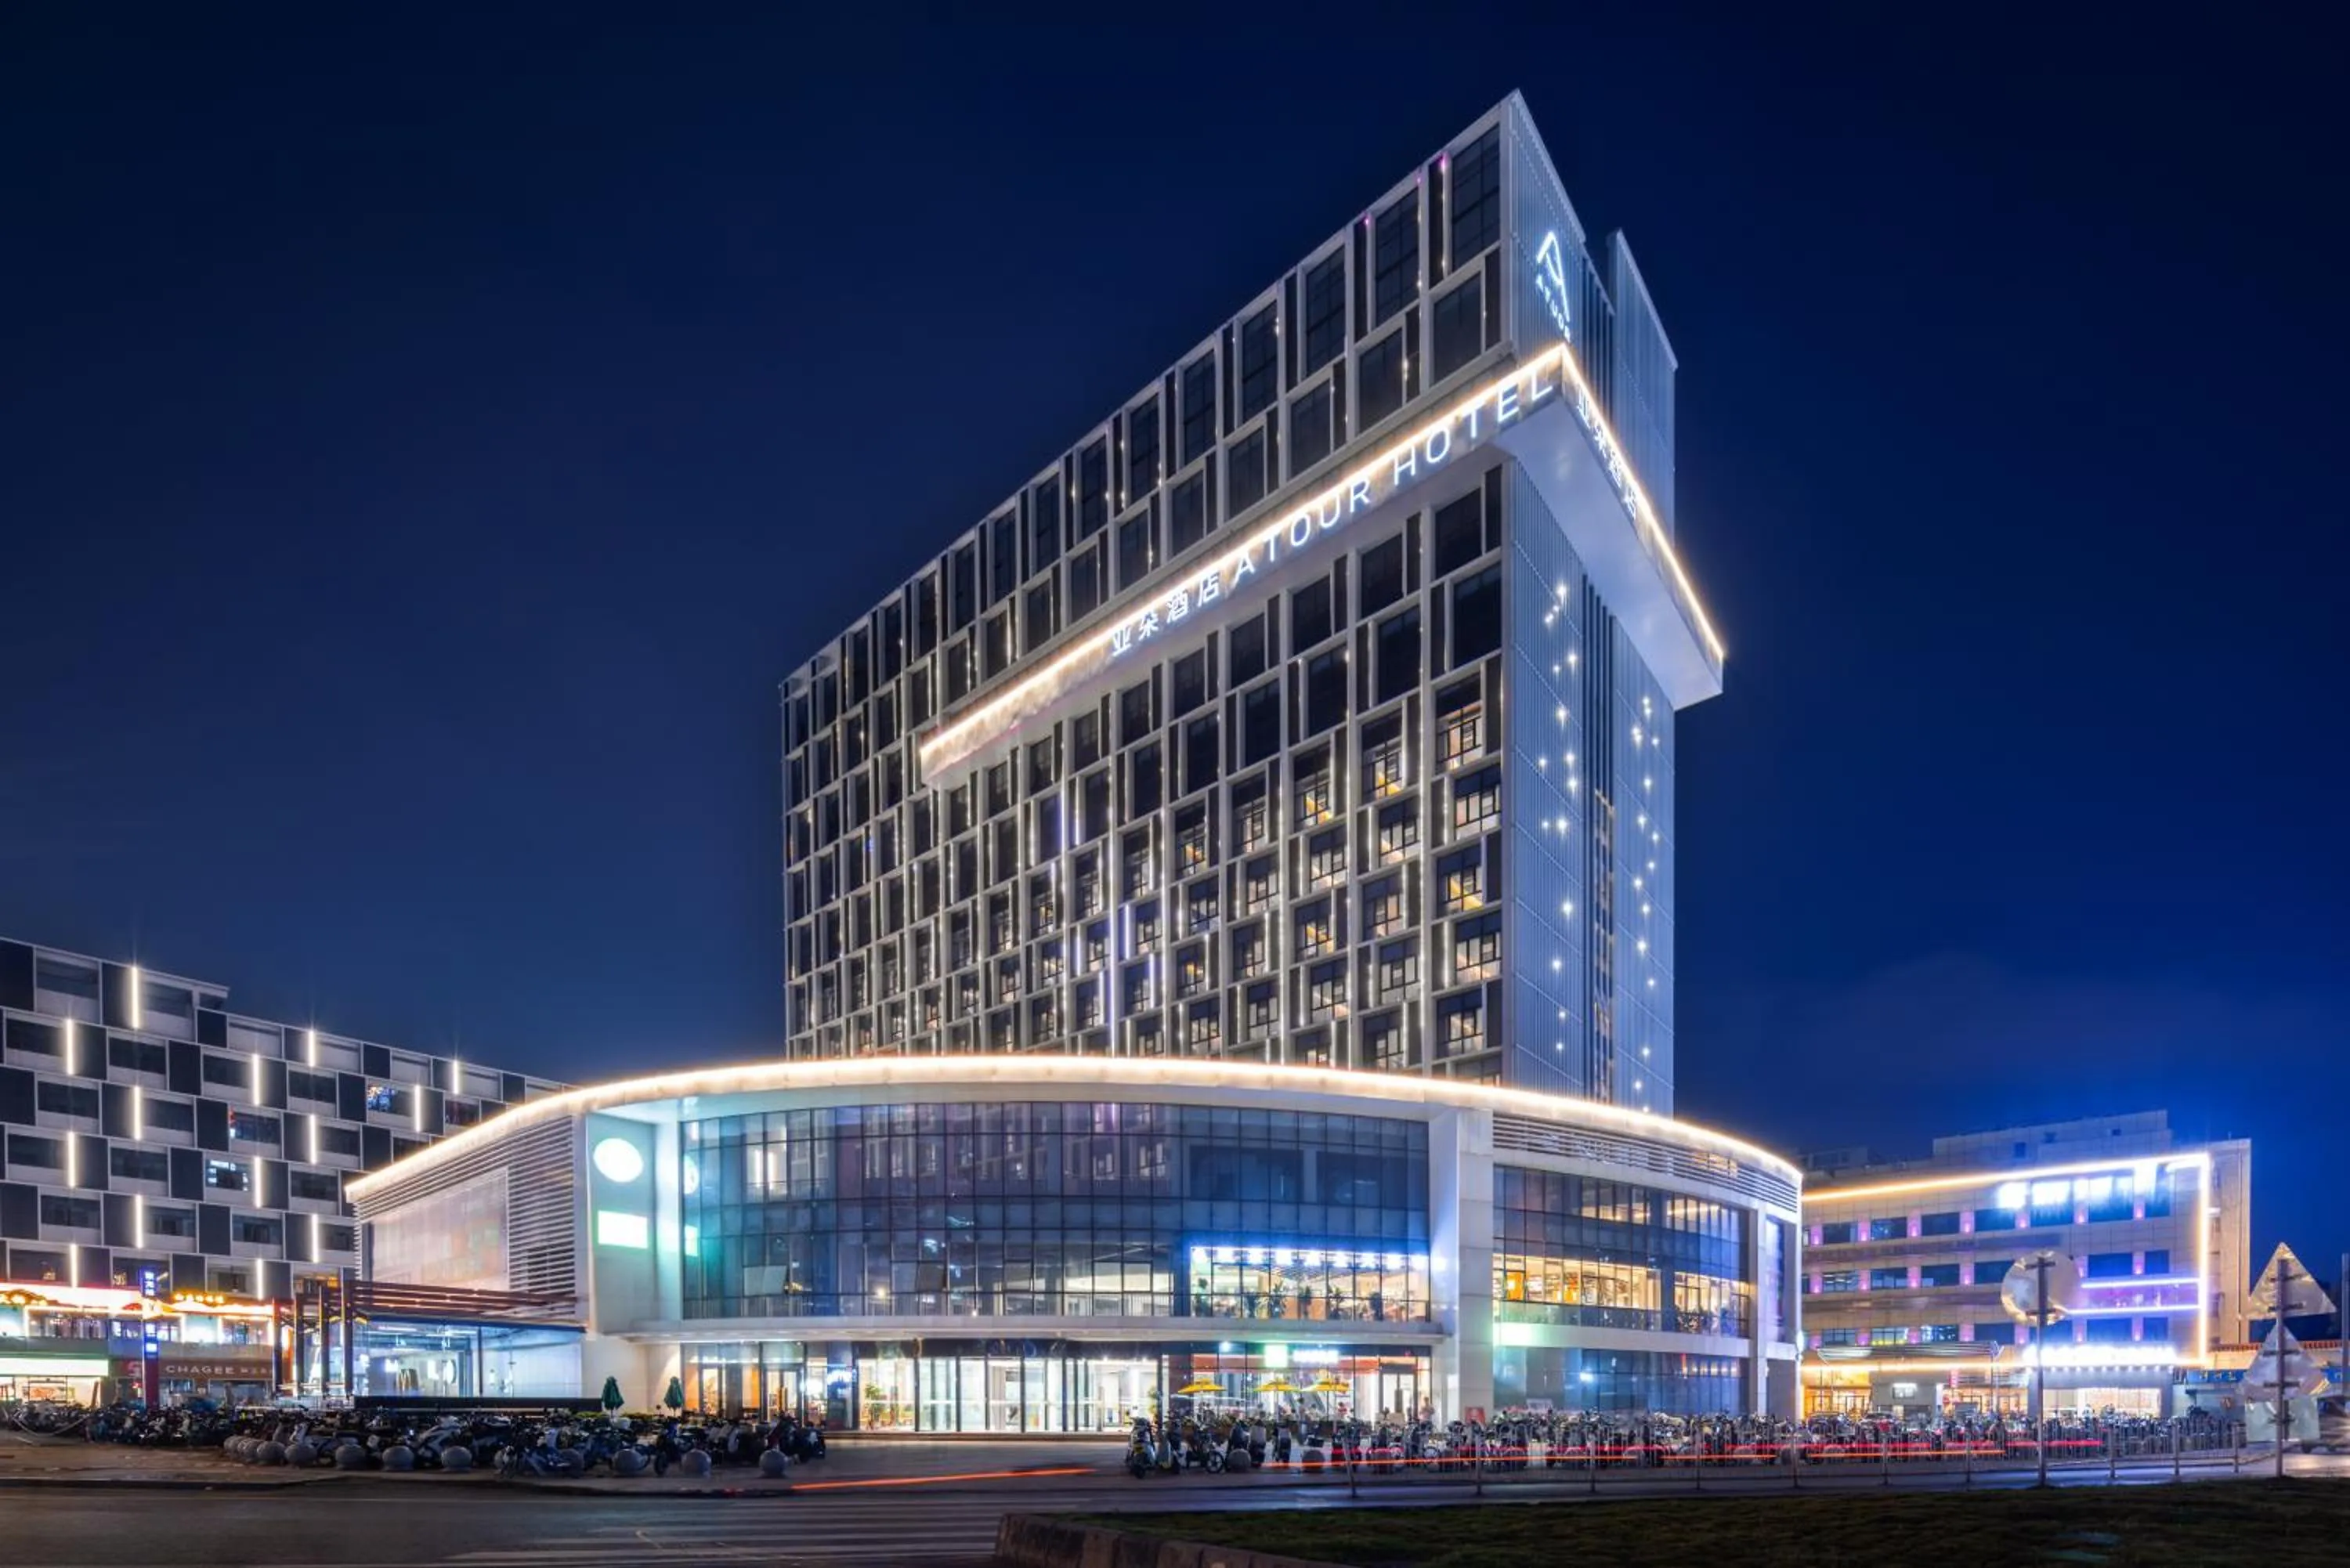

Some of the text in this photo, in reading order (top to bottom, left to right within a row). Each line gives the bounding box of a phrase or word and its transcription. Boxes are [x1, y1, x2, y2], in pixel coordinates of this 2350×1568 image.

[1111, 368, 1553, 658] 亚朵酒店 ATOUR HOTEL
[164, 1365, 234, 1375] CHAGEE
